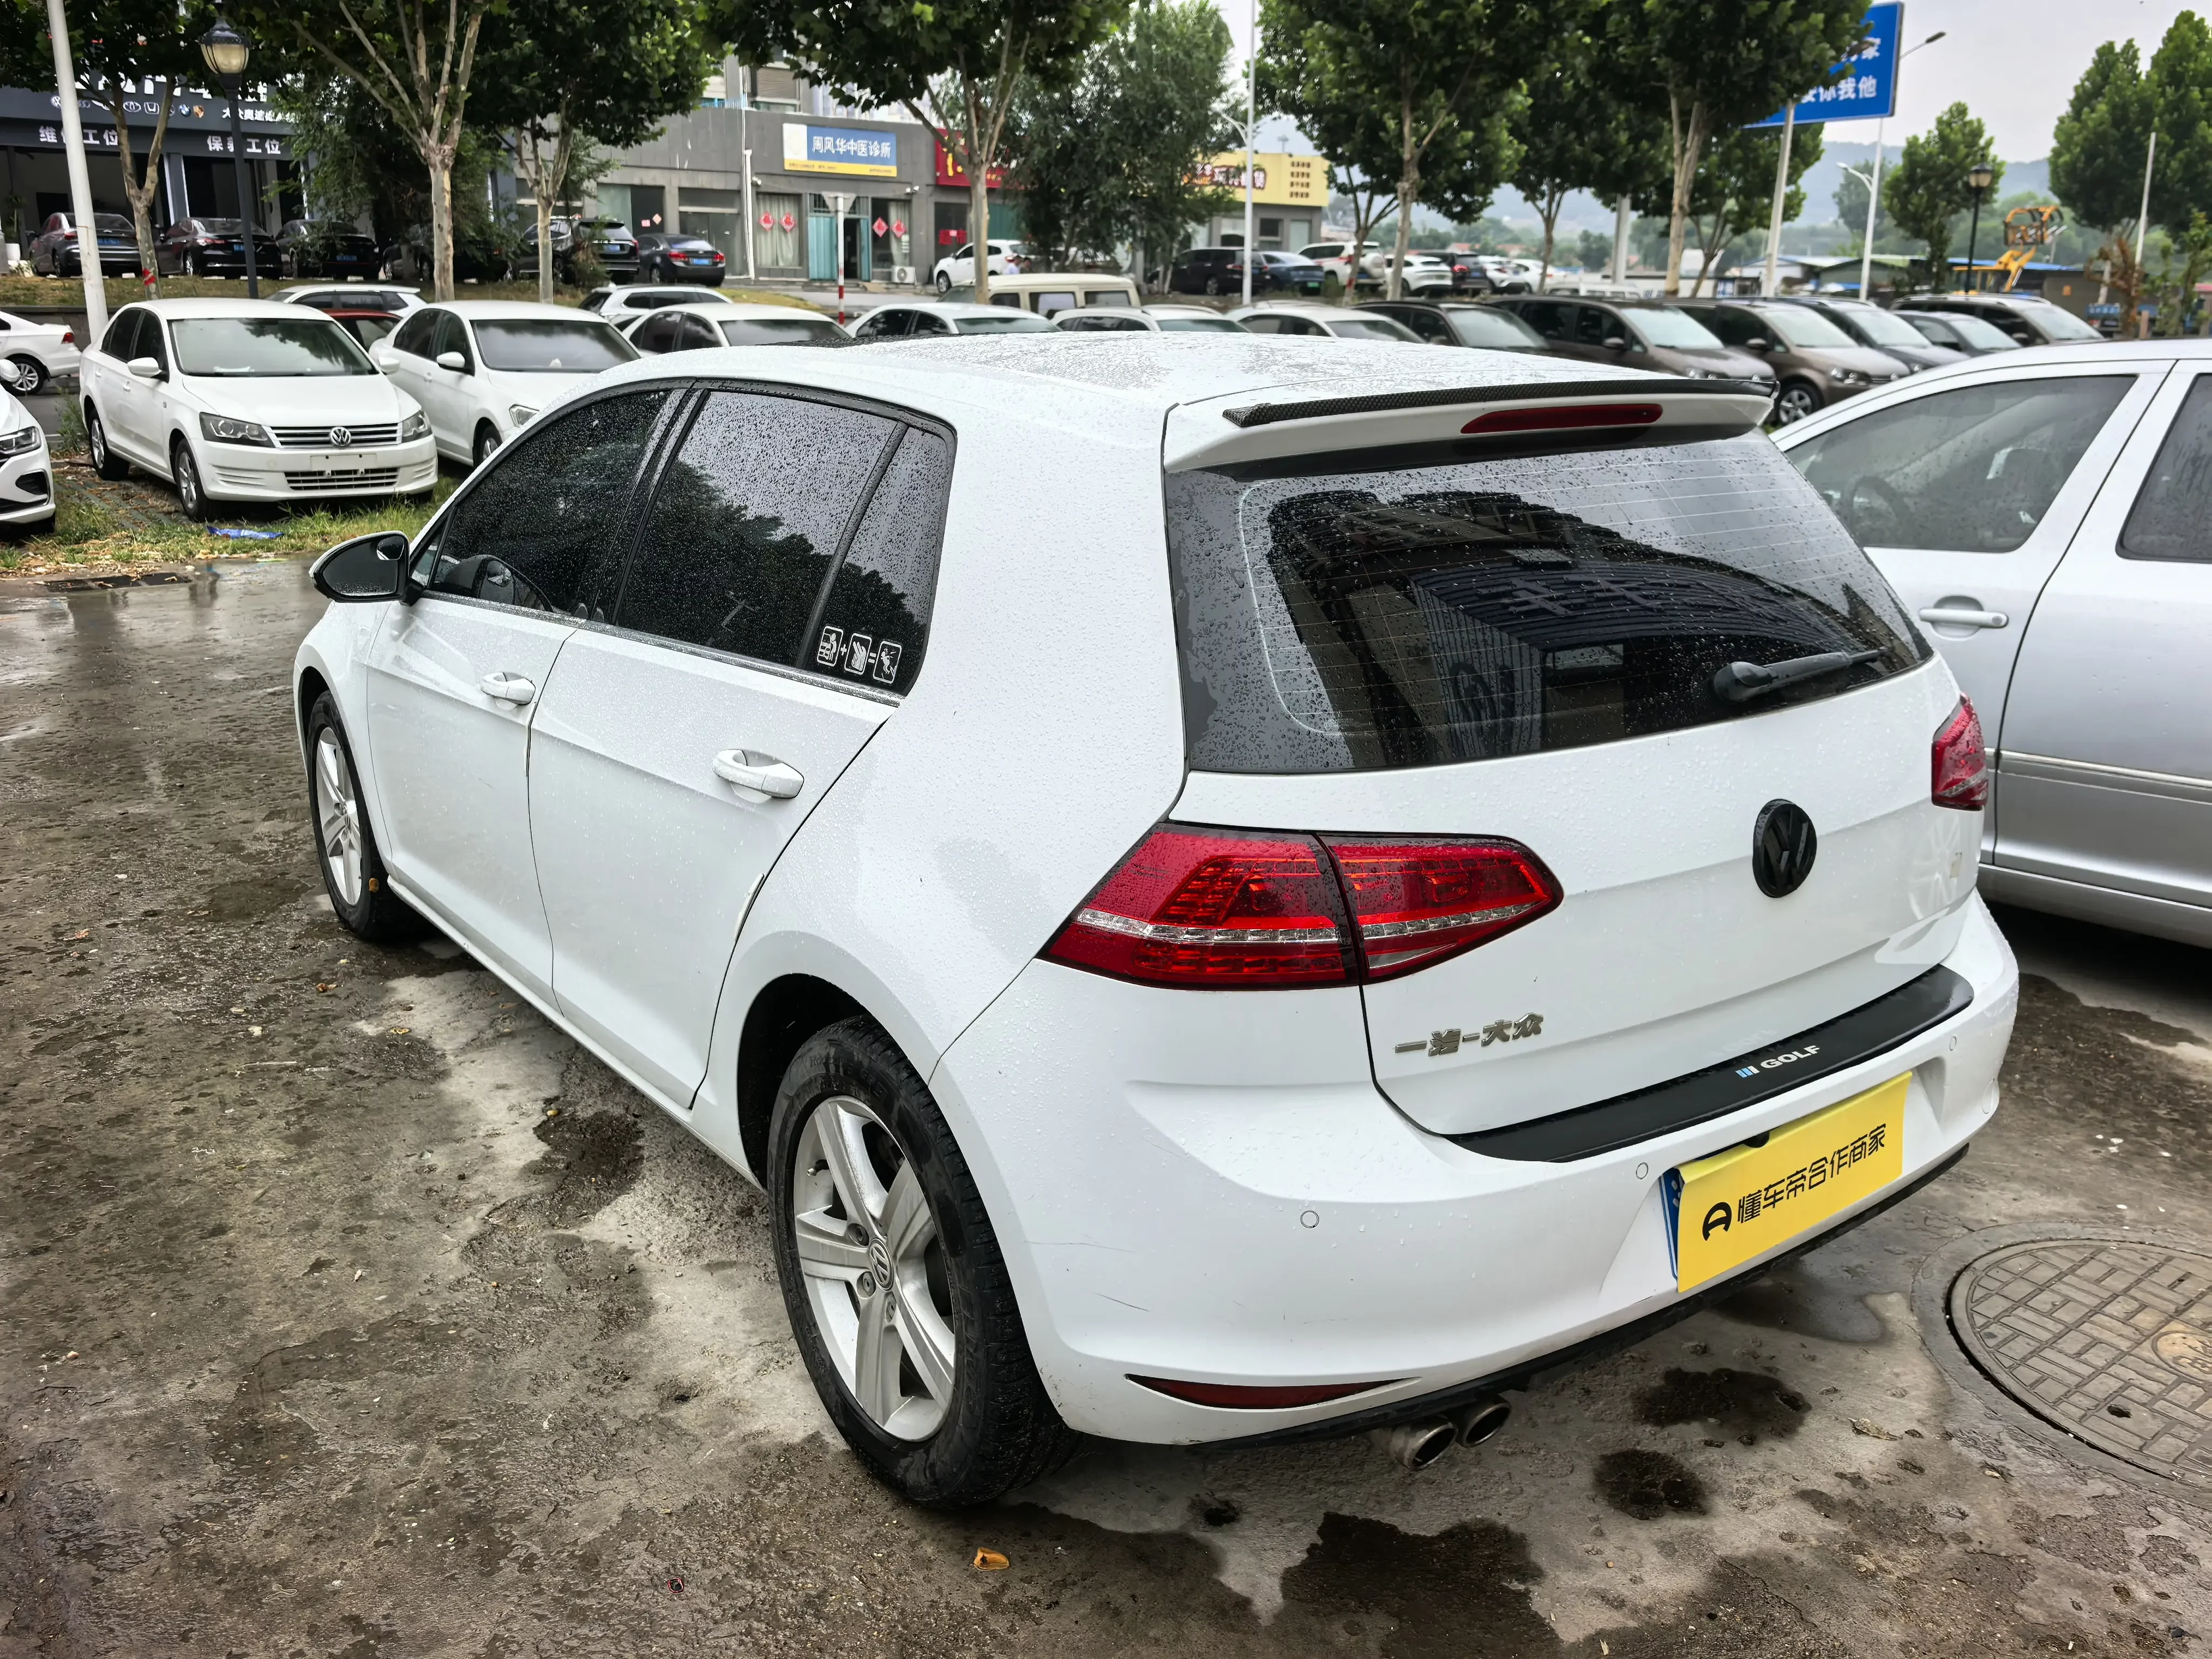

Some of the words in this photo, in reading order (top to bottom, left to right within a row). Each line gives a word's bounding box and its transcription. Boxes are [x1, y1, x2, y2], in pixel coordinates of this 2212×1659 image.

[39, 126, 118, 146] 维工位
[1761, 1046, 1819, 1068] GOLF
[1737, 1123, 1886, 1224] 懂车帝合作商家
